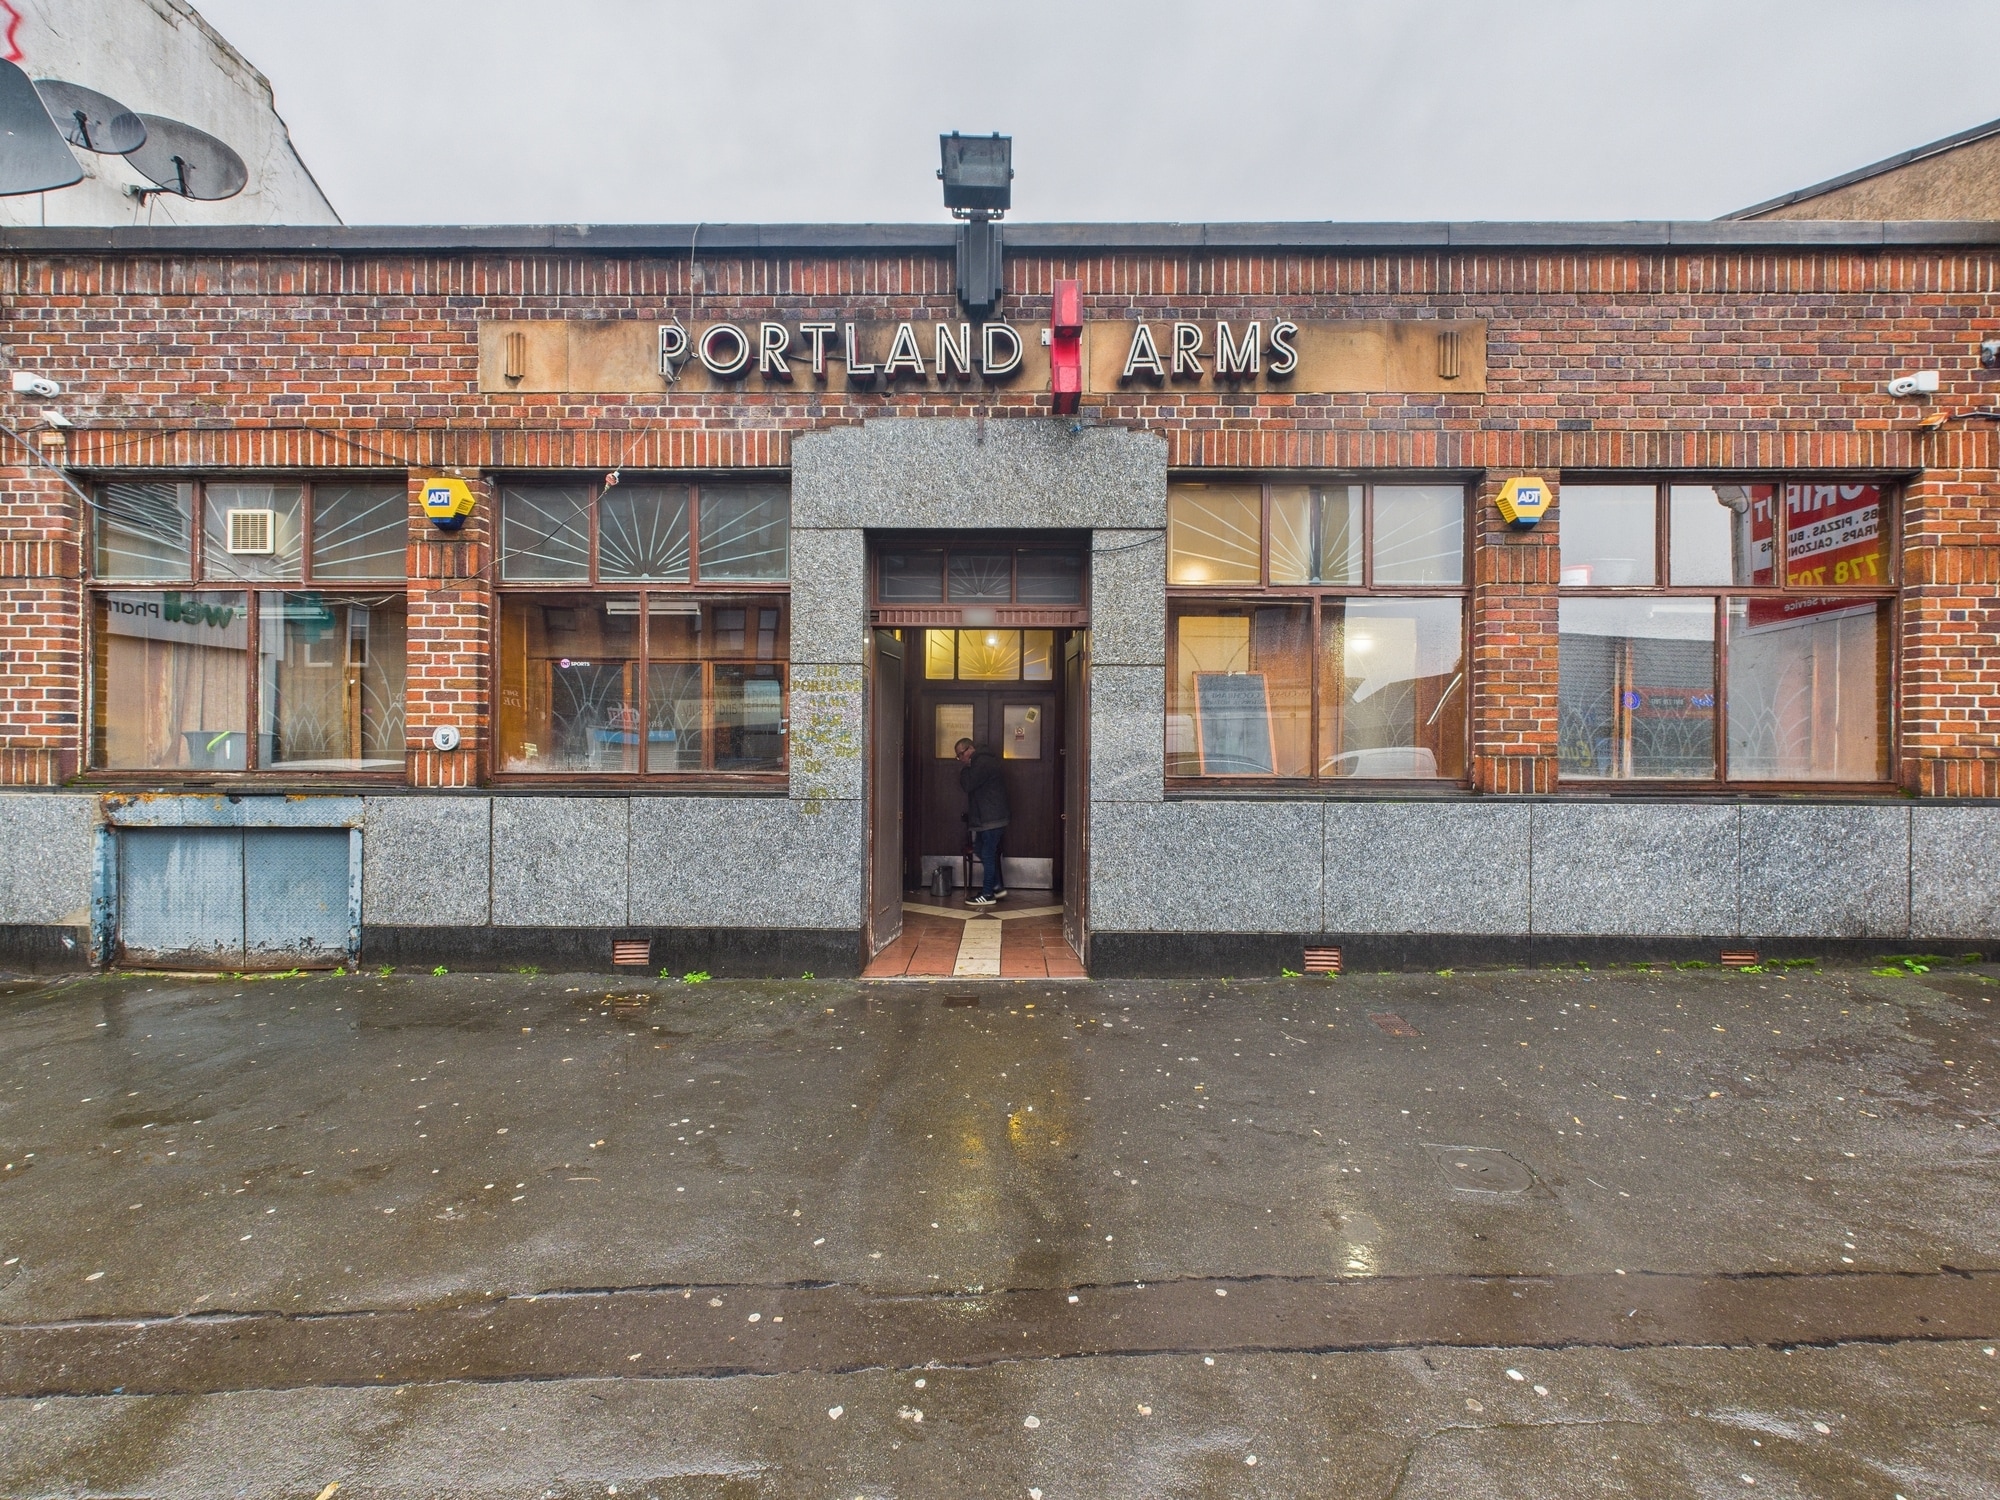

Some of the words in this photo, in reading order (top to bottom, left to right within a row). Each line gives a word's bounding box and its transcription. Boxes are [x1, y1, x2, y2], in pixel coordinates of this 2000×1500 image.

[658, 321, 1023, 382] PORTLAND
[1122, 321, 1299, 380] ARMS
[428, 491, 450, 504] ADT
[1517, 491, 1540, 503] ADT
